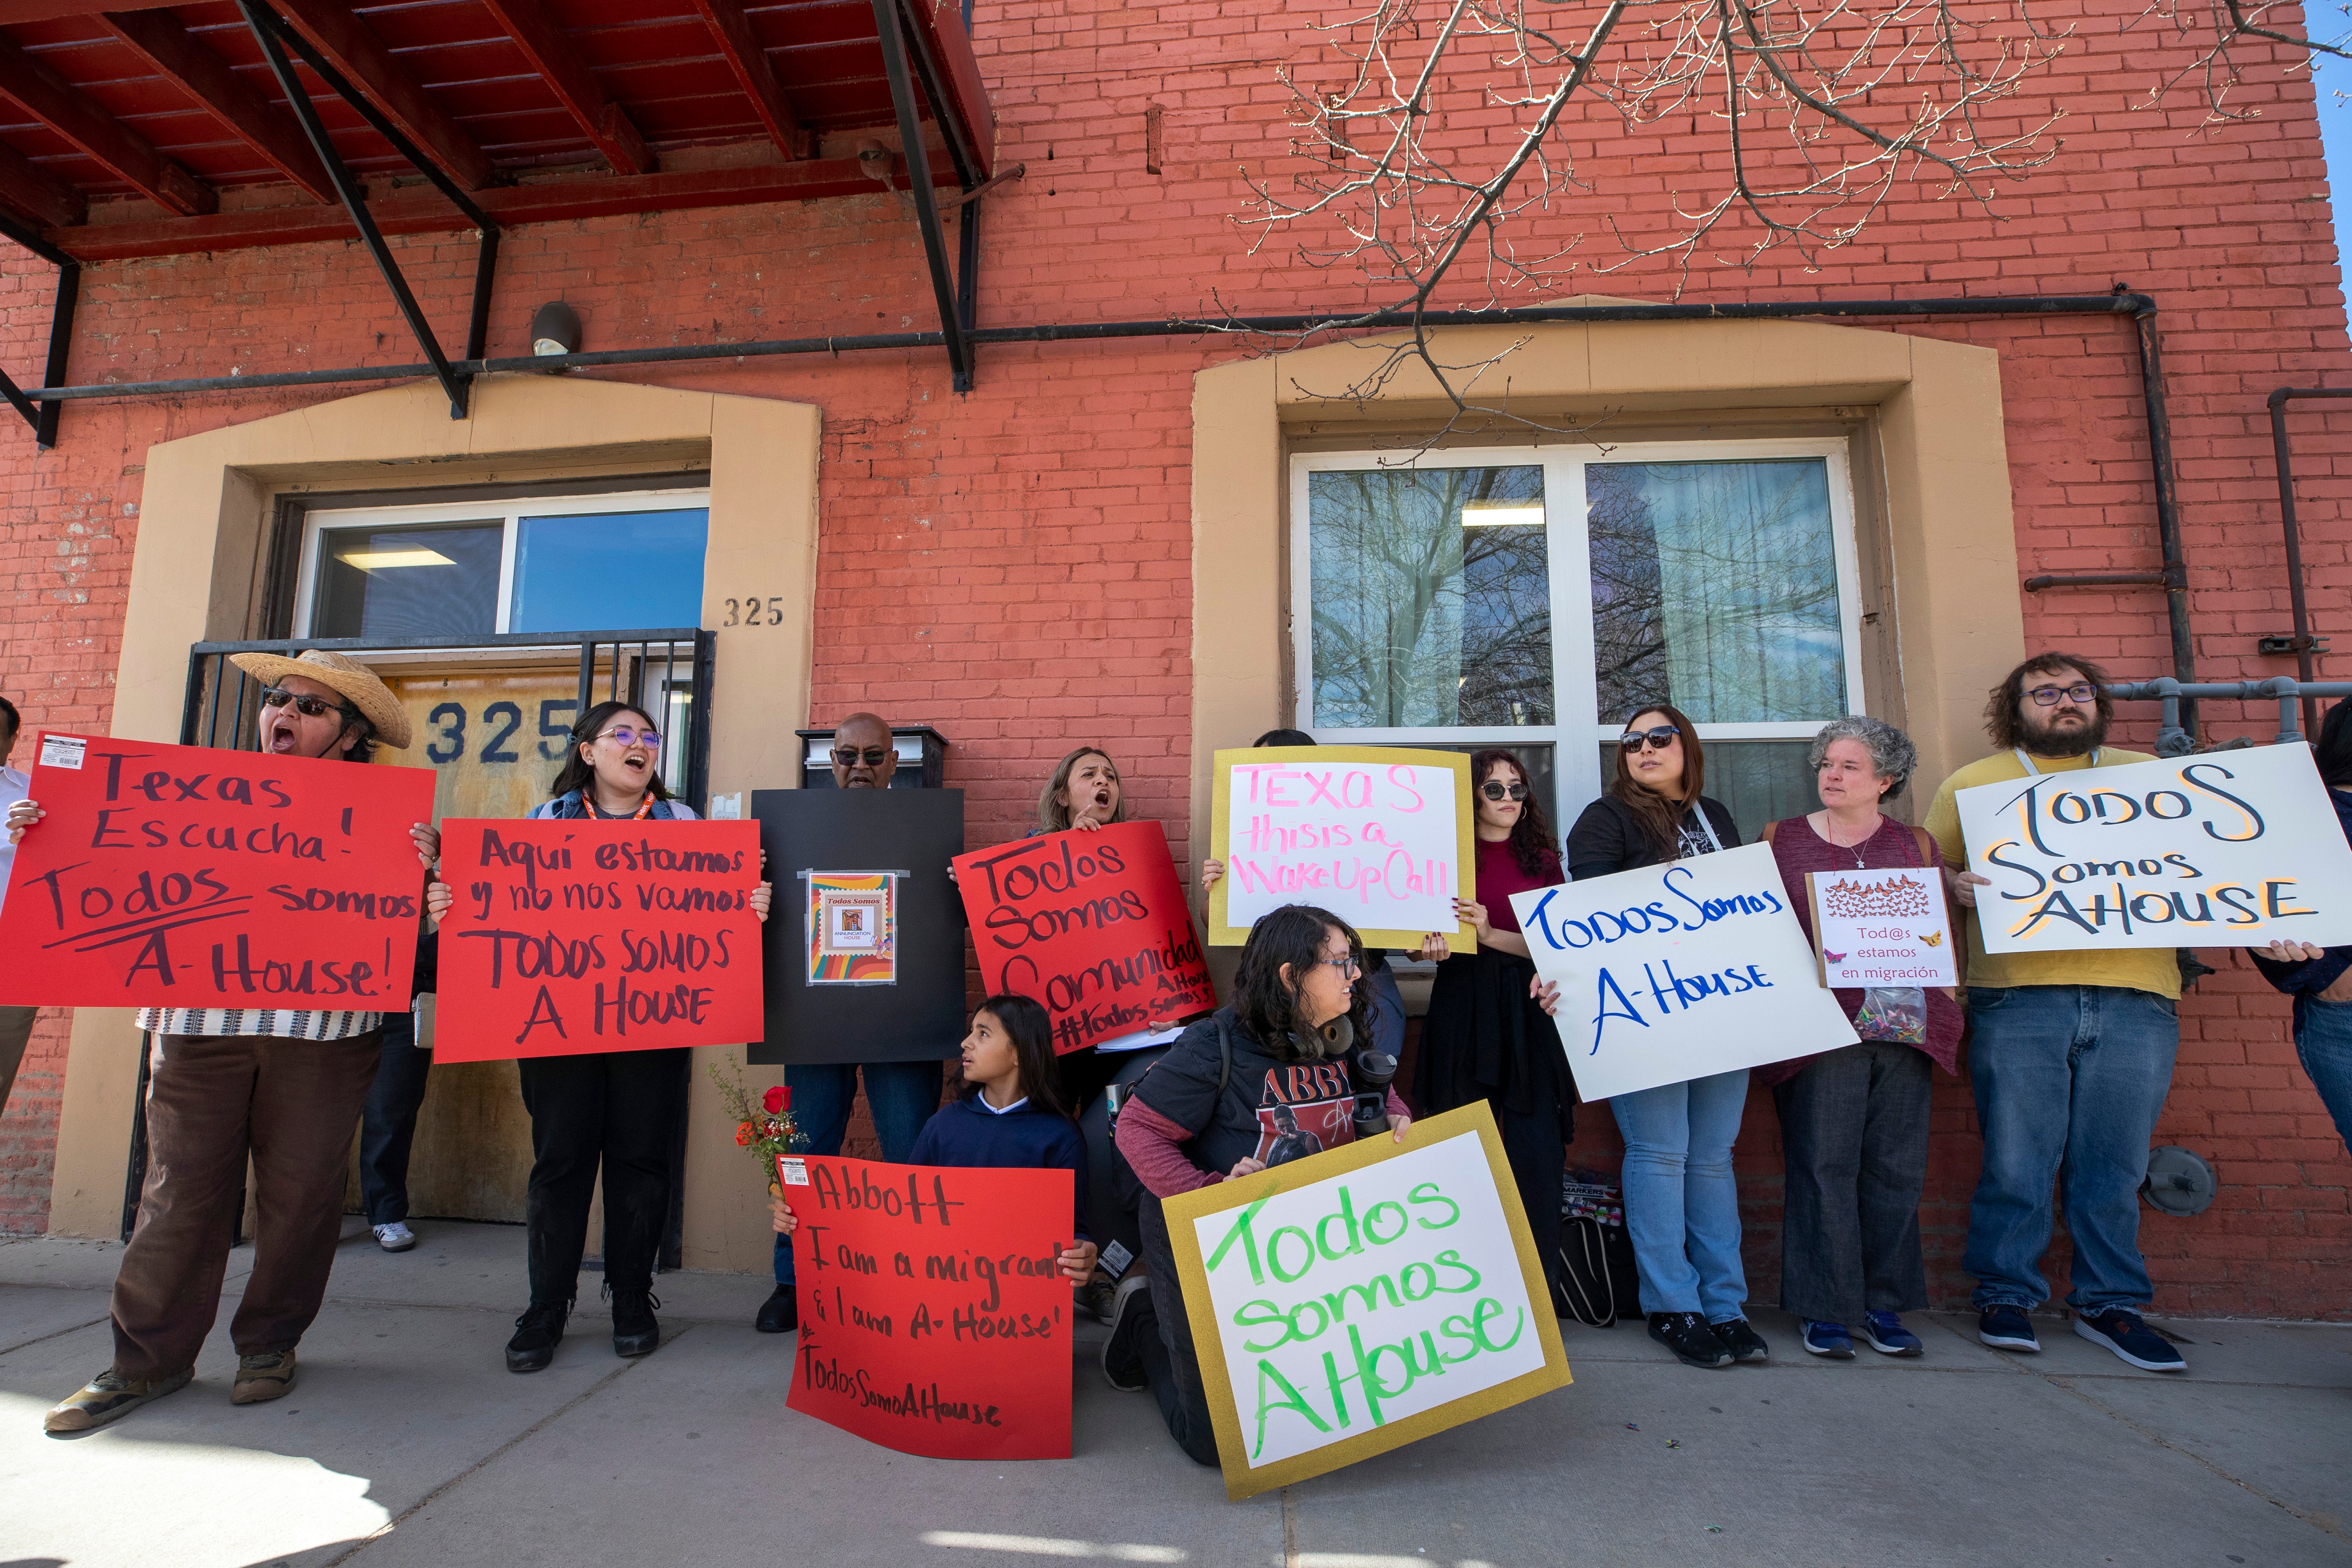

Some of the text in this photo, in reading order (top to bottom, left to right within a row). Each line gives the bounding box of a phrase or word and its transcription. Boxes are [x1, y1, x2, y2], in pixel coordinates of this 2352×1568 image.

[723, 597, 783, 627] 325
[426, 699, 578, 764] 325
[93, 753, 292, 808] Texas
[638, 804, 650, 816] HOPE
[1995, 763, 2265, 857] TODOS
[91, 807, 352, 862] Escucha!
[479, 828, 744, 890] Aquí estamos
[1361, 821, 1405, 848] a
[21, 861, 417, 930] Todos somos
[470, 880, 745, 921] y no nos vamos
[969, 839, 1125, 906] Todos
[1383, 849, 1447, 900] Call
[1663, 867, 1783, 931] Somos
[1982, 837, 2203, 904] Somos
[985, 889, 1149, 950] Somos
[1857, 927, 1911, 940] Tod@s
[125, 930, 391, 996] A-House!
[457, 928, 733, 989] TODOS SOMOS
[996, 919, 1203, 1013] Comunidad
[1842, 967, 1938, 981] en migración
[1857, 947, 1916, 958] estamos
[515, 976, 715, 1045] A HOUSE
[811, 1163, 965, 1226] Abbott
[1563, 1187, 1604, 1196] MARKERS
[806, 1225, 831, 1271] I
[838, 1243, 878, 1275] am
[894, 1251, 914, 1279] a
[1205, 1179, 1461, 1287] Todos
[836, 1286, 844, 1327] I
[852, 1304, 892, 1338] am
